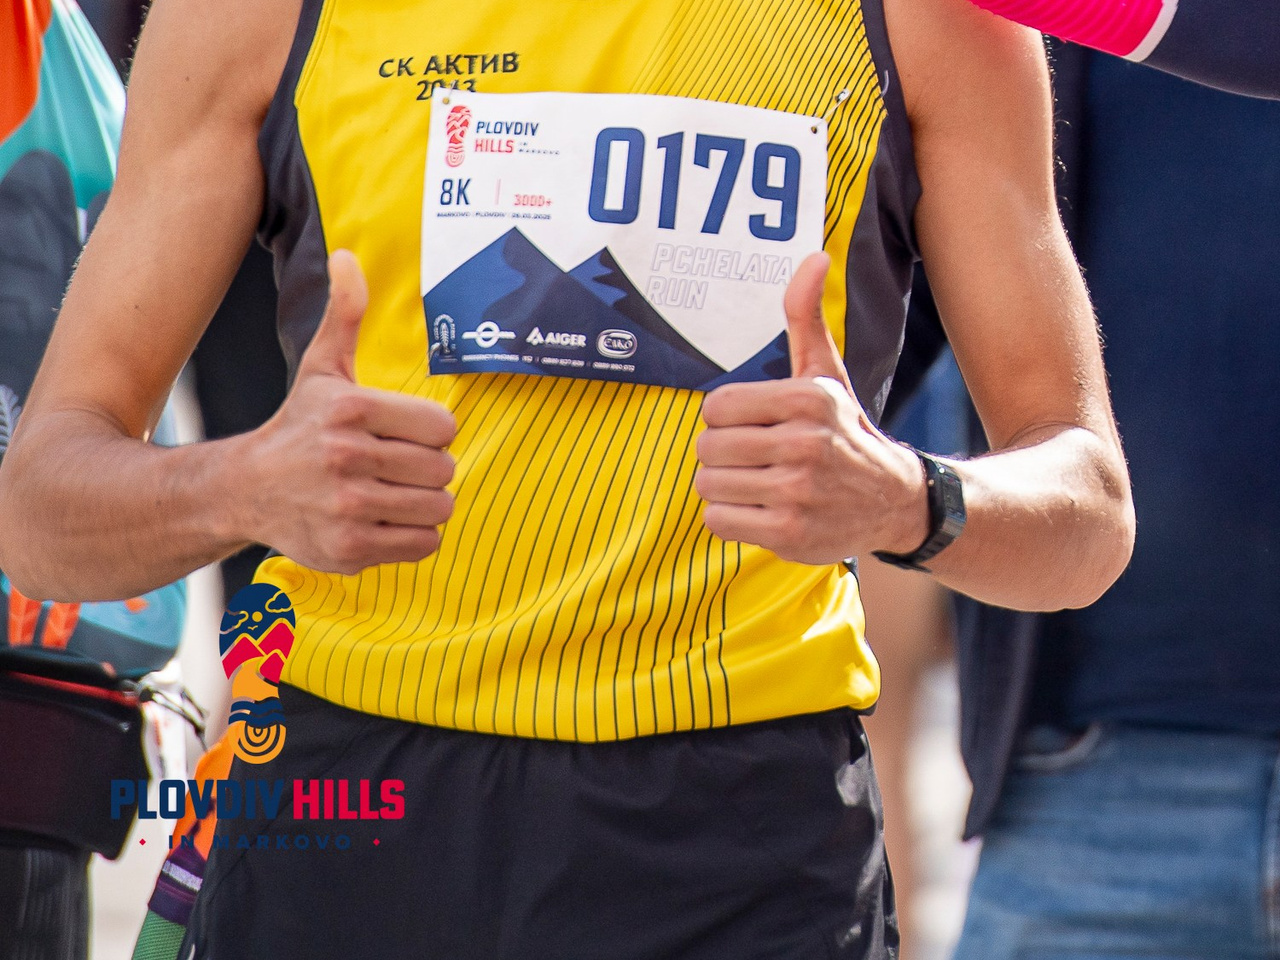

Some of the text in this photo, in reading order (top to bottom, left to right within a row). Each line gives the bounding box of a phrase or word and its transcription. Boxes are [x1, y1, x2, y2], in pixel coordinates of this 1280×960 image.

[378, 51, 520, 78] СК АКТИВ
[475, 120, 540, 137] PLOVDIV
[474, 138, 515, 154] HILLS
[439, 177, 472, 206] 8K
[587, 126, 802, 242] 0179
[651, 242, 794, 286] PCHELATA
[645, 275, 710, 310] RUN
[544, 331, 587, 348] AIGER
